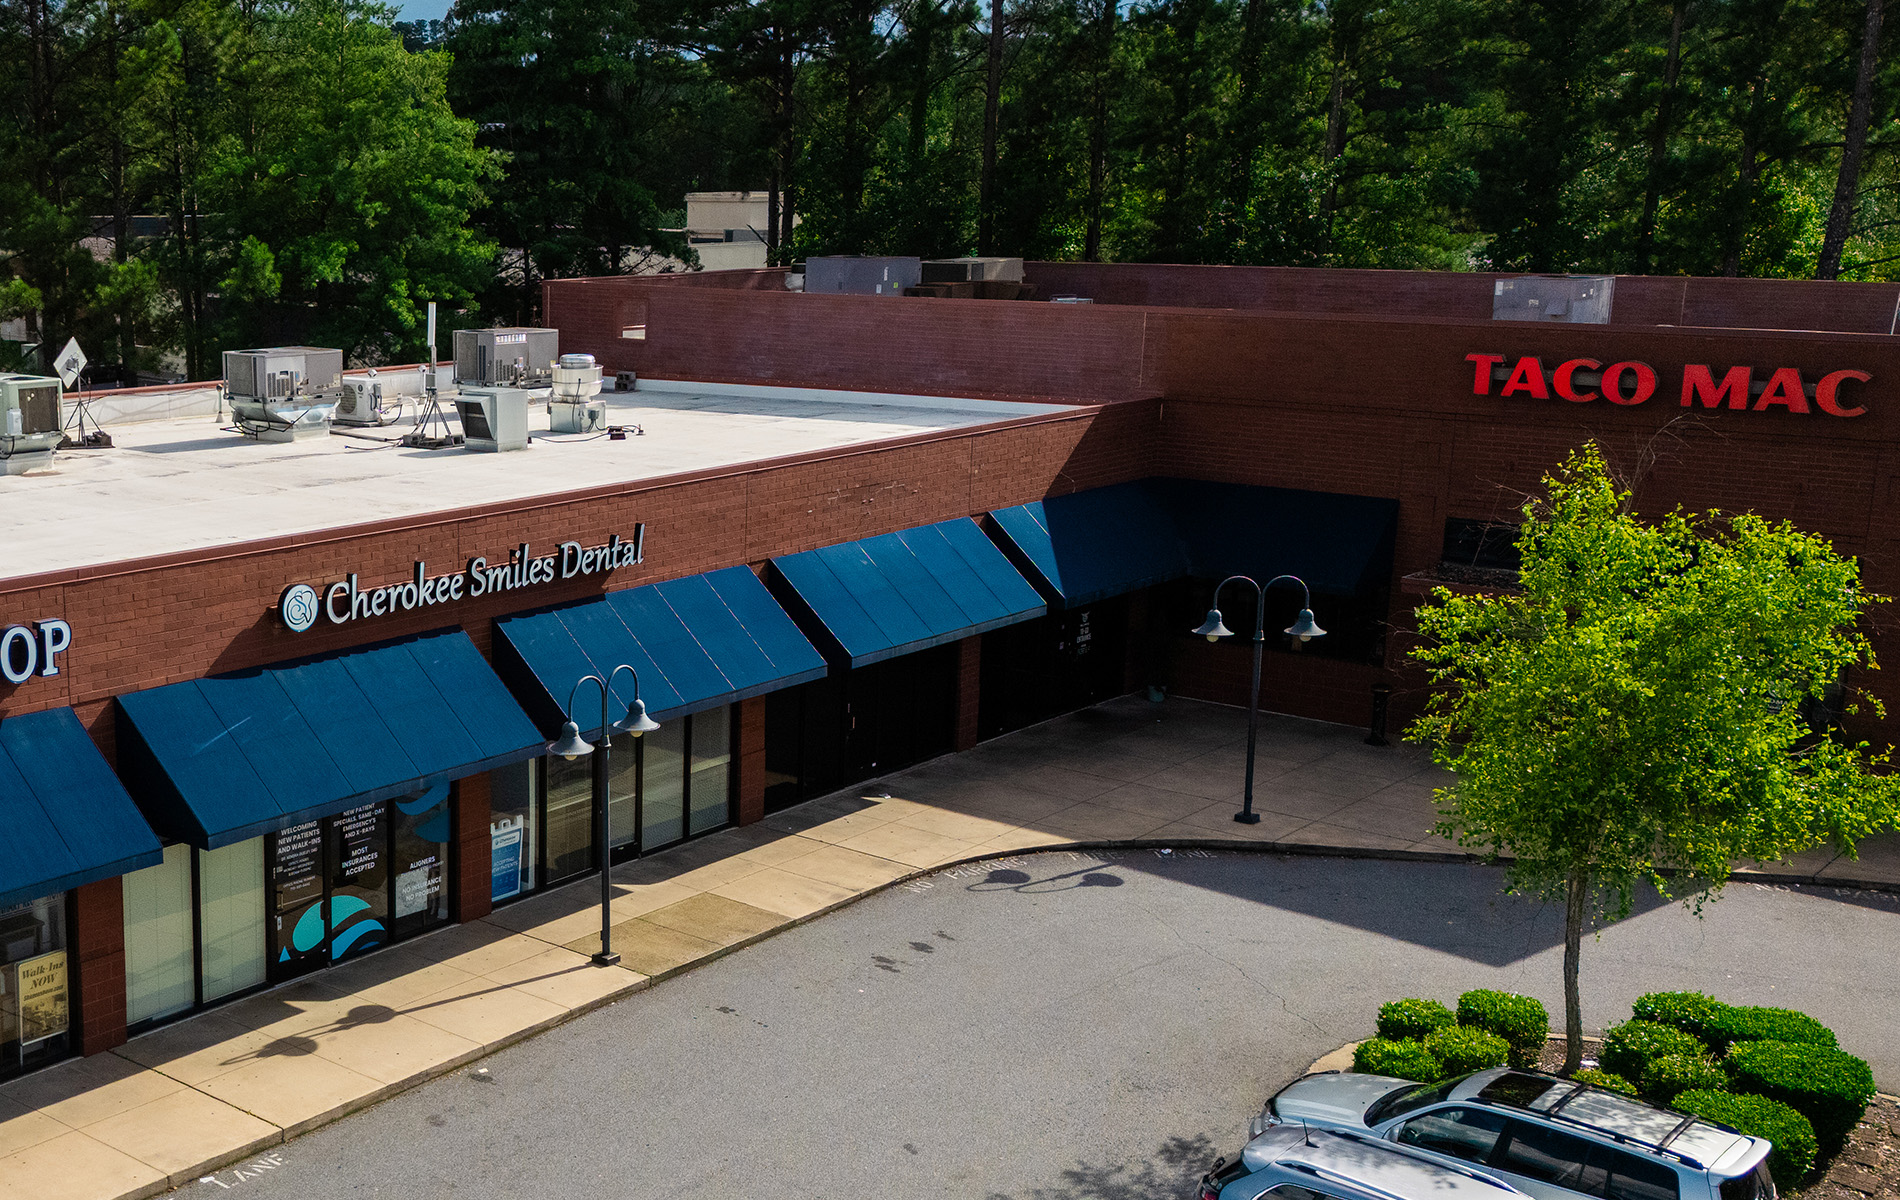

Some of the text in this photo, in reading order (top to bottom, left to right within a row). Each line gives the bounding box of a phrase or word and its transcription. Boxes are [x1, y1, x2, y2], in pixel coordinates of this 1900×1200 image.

[1465, 353, 1873, 418] TACO MAC
[326, 524, 645, 624] Cherokee Smiles Dental
[343, 802, 376, 817] NEW PATIENT
[358, 807, 385, 820] SAME-DAY
[281, 820, 318, 836] WELCOMING
[344, 824, 376, 839] AND X-RAYS
[277, 845, 291, 855] AND
[291, 836, 321, 851] WALK-INS
[278, 828, 321, 846] NEW PATIENTS
[341, 851, 378, 869] INSURANCES
[351, 846, 369, 857] MOST
[345, 861, 376, 877] ACCEPTED
[409, 855, 436, 869] ALIGNERS
[402, 875, 442, 894] NO INSURANCE
[405, 885, 440, 902] NO PROBLEM
[30, 972, 58, 990] NOW
